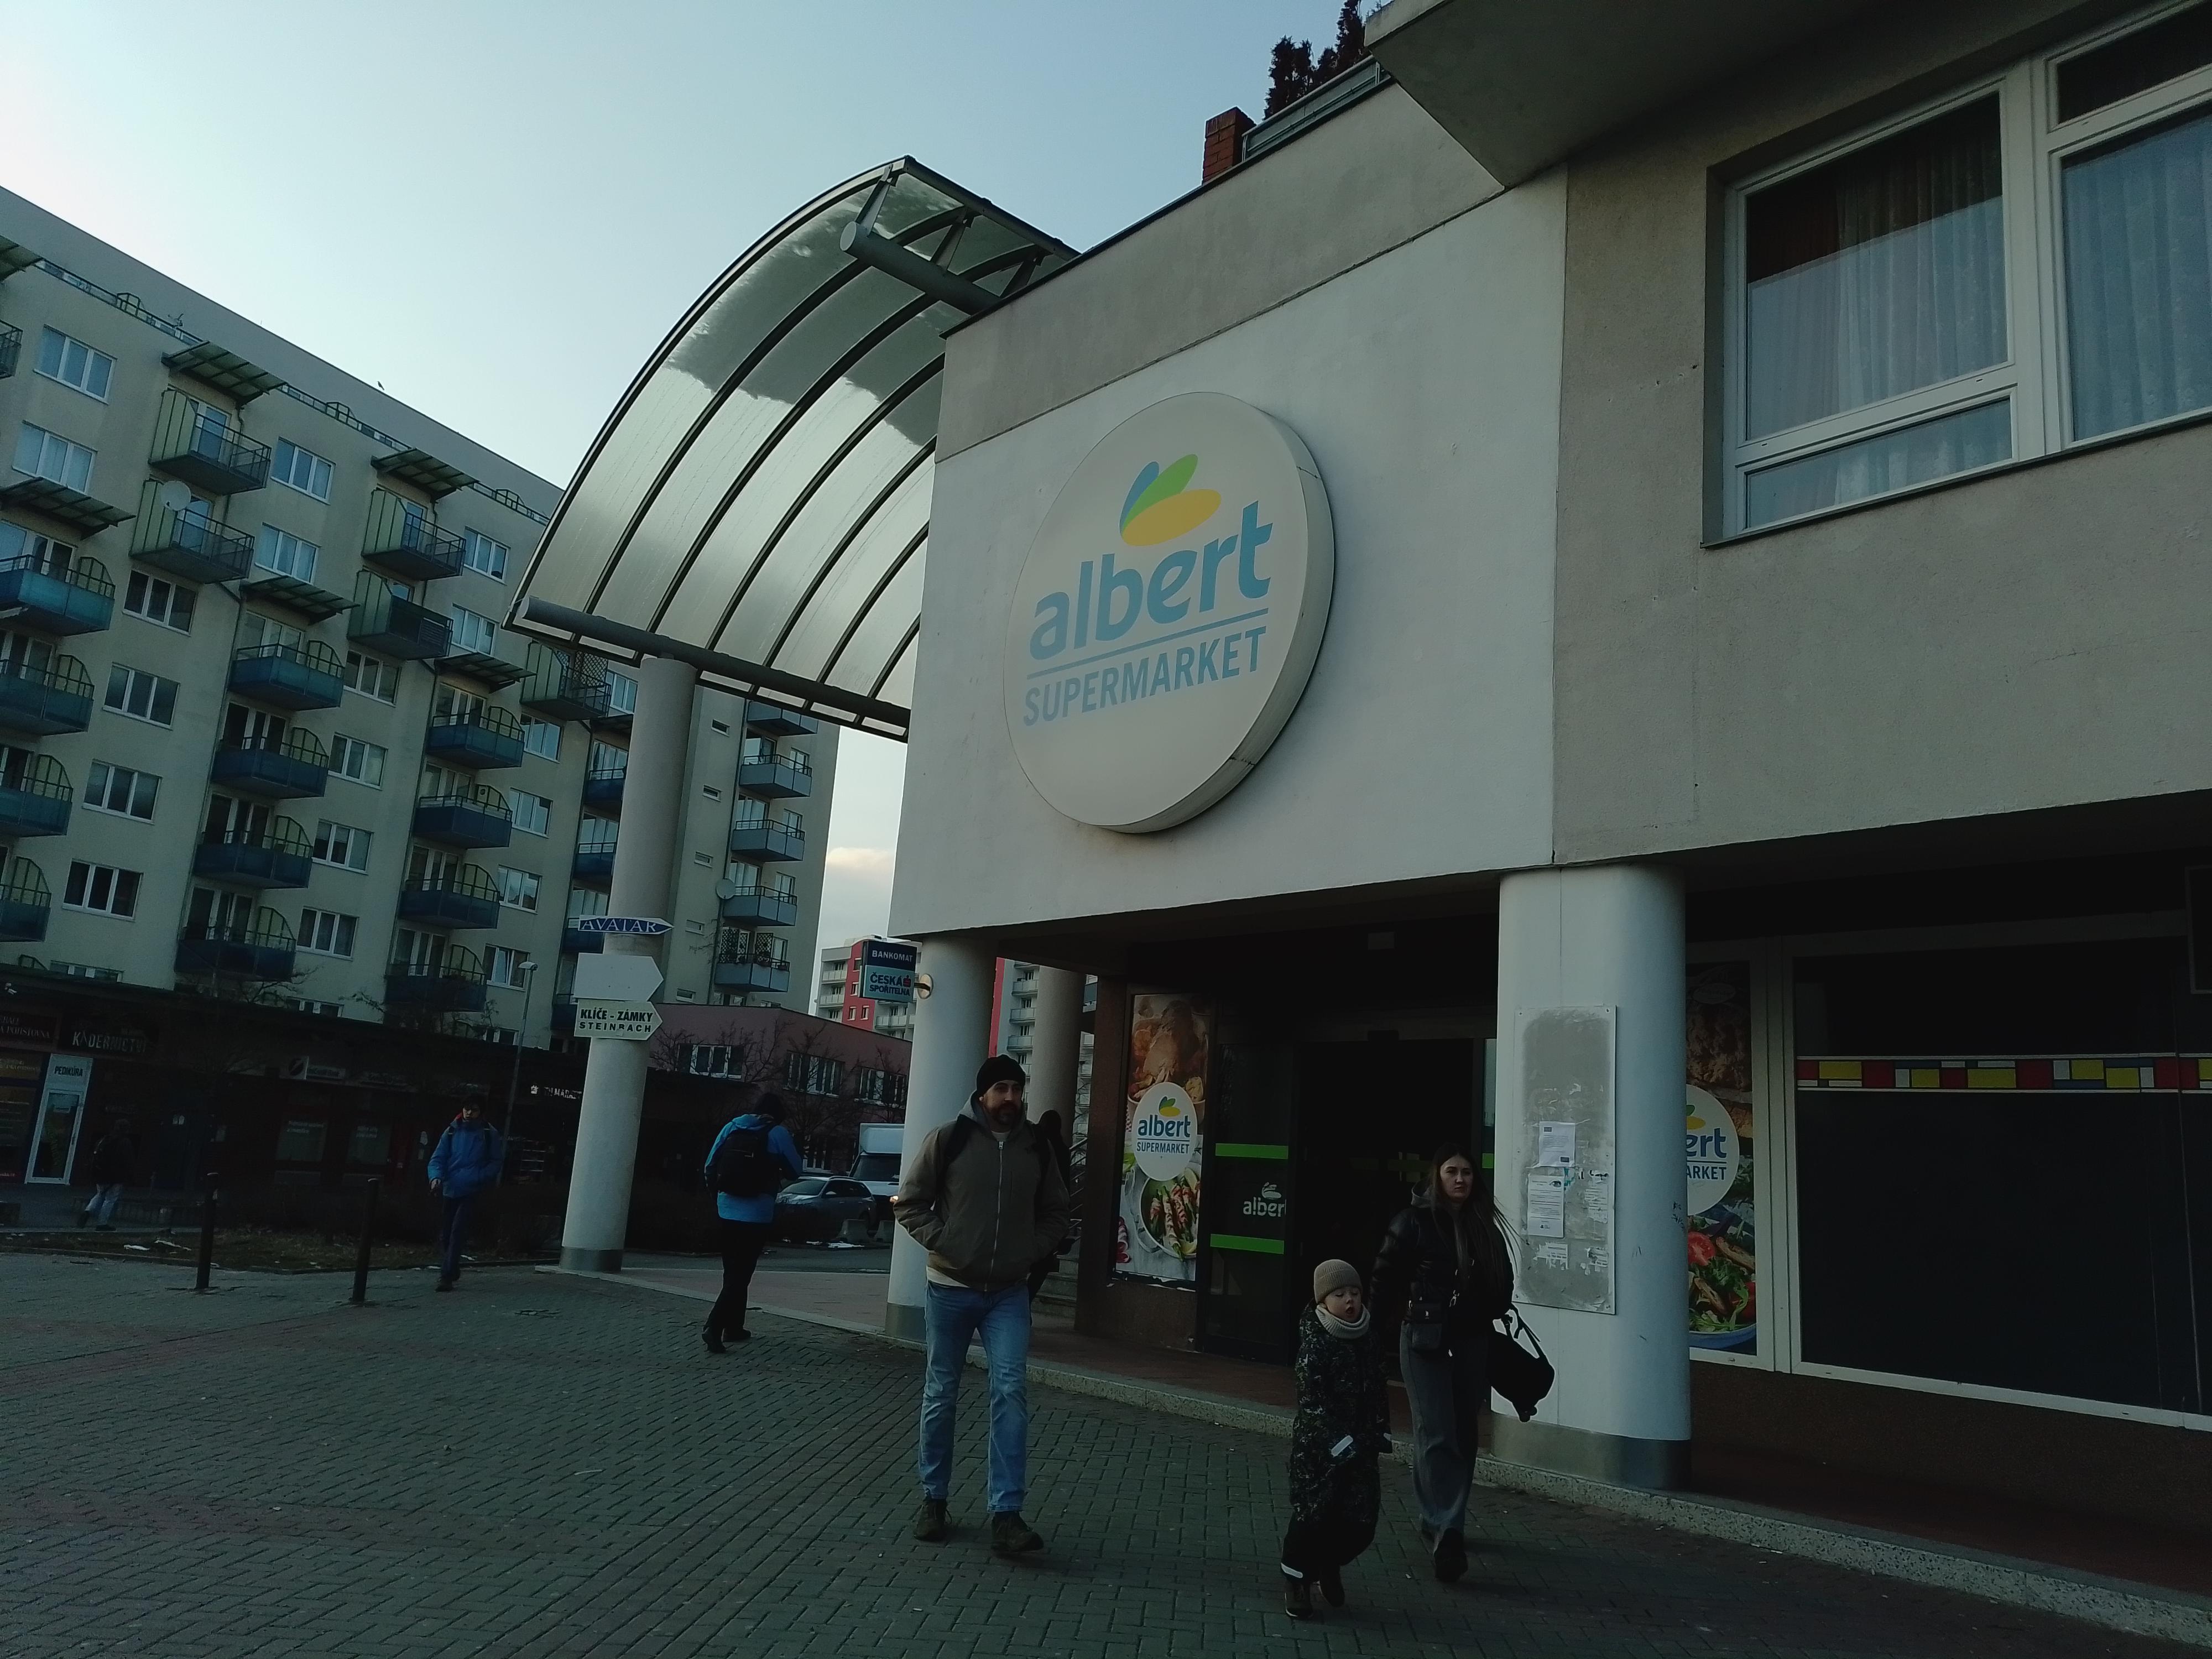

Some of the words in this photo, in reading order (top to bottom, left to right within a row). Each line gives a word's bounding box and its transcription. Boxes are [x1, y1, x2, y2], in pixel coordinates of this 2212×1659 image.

[1029, 500, 1274, 660] albert
[1023, 625, 1267, 727] SUPERMARKET
[581, 917, 657, 932] AVATAR
[872, 950, 912, 962] BANKOMAT
[870, 972, 902, 987] ČESKÁ
[869, 984, 910, 996] SPOŘITELNA
[580, 1007, 607, 1020] KLÍČE
[617, 1009, 653, 1022] ZÁMKY
[1138, 1114, 1191, 1138] albert
[1136, 1141, 1190, 1154] SUPERMARKET
[1243, 1196, 1287, 1218] alber
